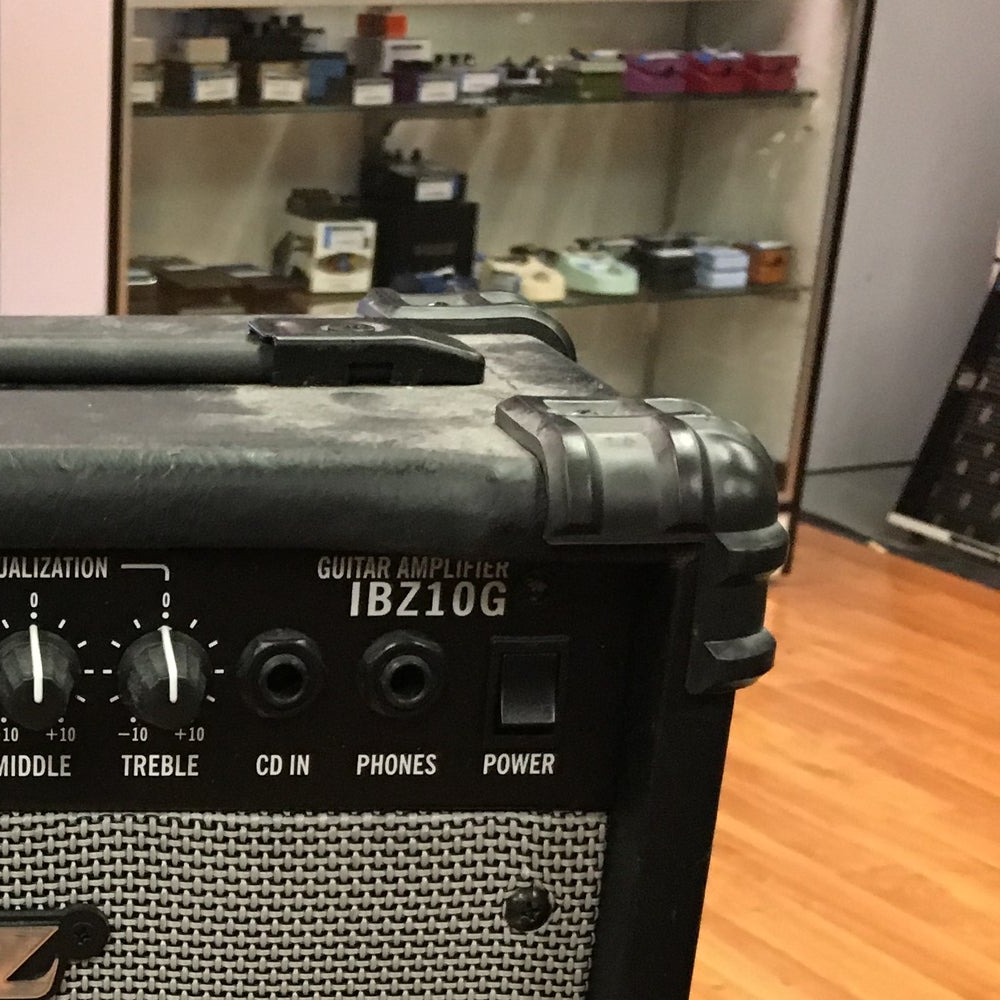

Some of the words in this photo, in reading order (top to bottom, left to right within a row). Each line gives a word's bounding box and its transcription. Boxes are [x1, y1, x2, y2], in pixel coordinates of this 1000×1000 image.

[317, 556, 391, 580] GUITAR
[395, 556, 510, 579] AMPLIFIER
[29, 591, 39, 608] 0
[162, 591, 171, 608] 0
[349, 580, 508, 617] IBZ10G
[45, 726, 76, 742] +10
[117, 726, 148, 742] -10
[174, 726, 205, 742] +10
[121, 754, 199, 777] TREBLE
[255, 754, 283, 776] CD
[289, 754, 310, 776] IN
[356, 753, 437, 776] PHONES
[482, 753, 556, 775] POWER
